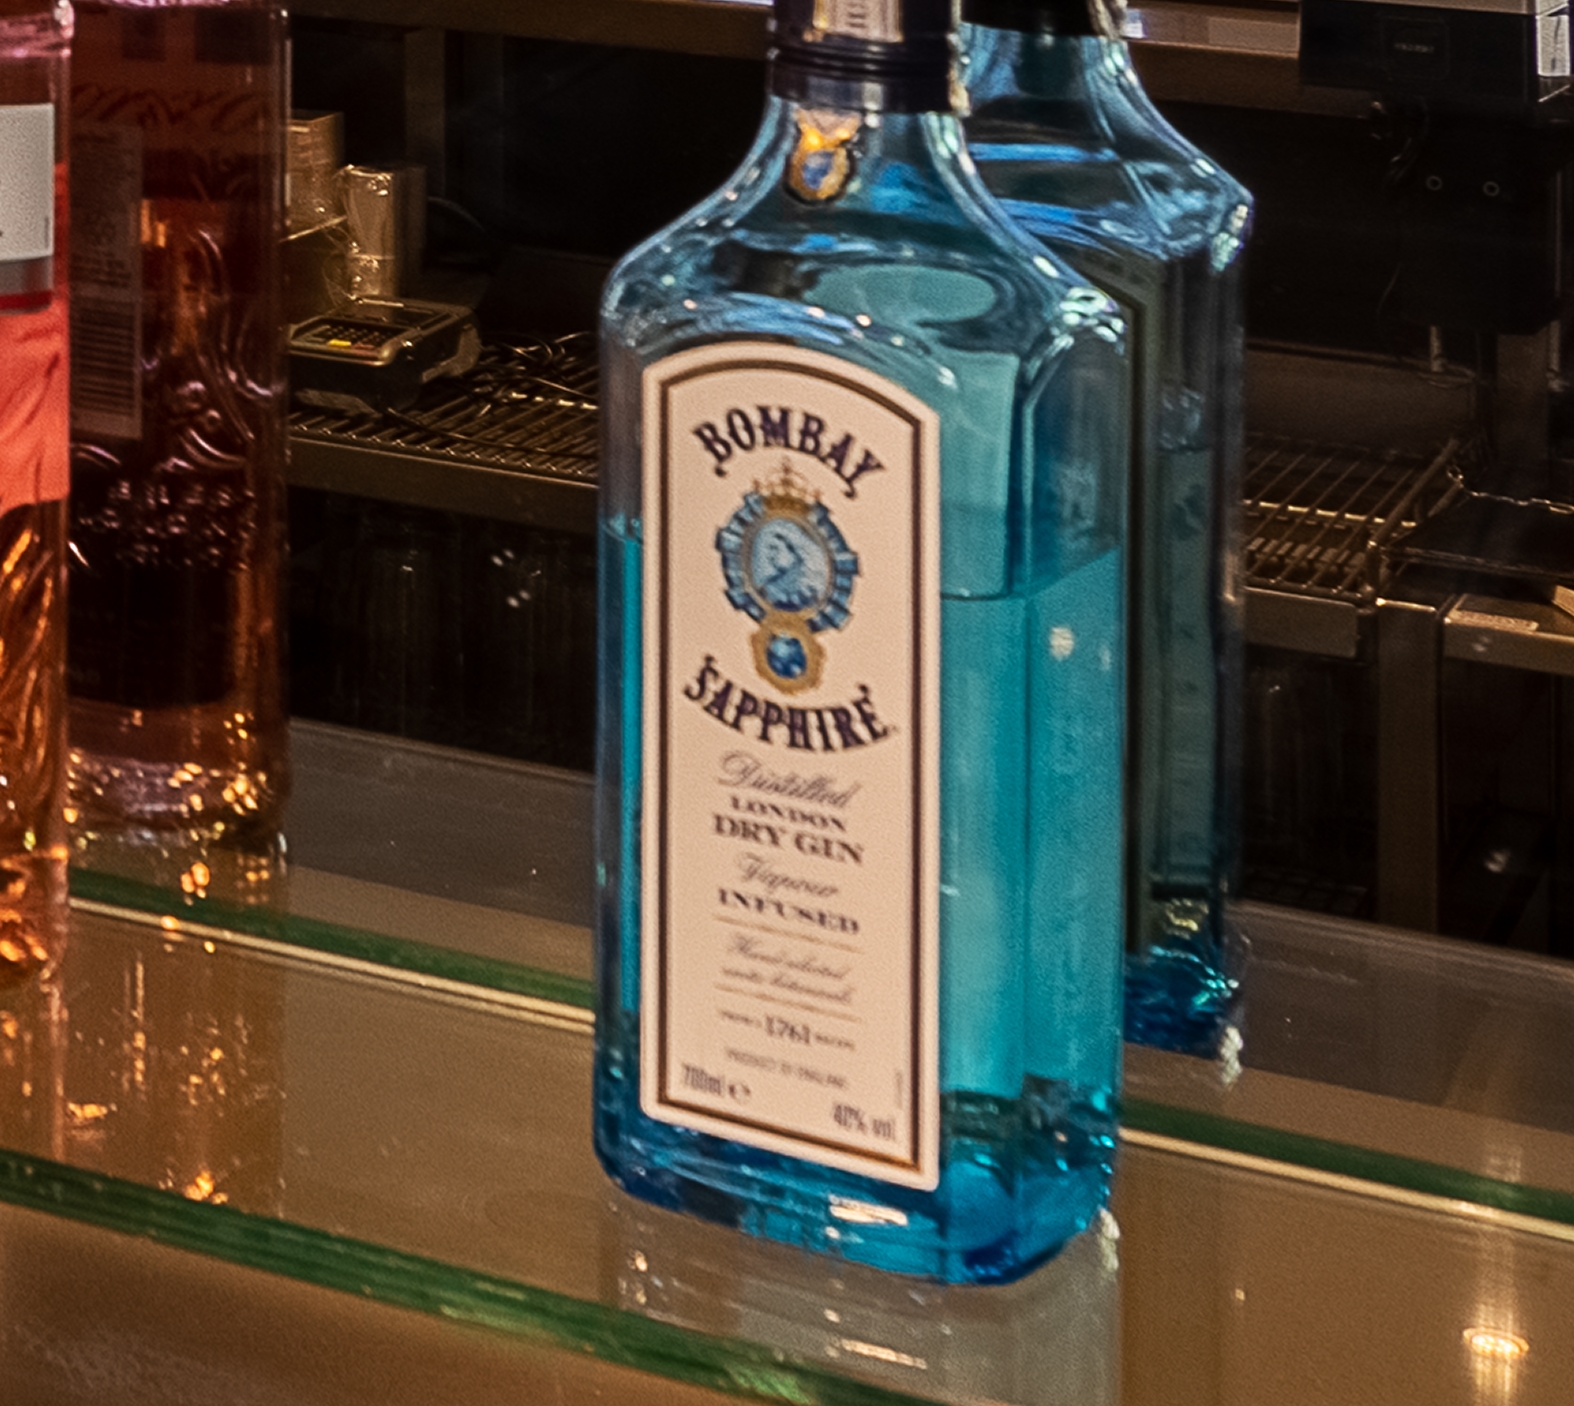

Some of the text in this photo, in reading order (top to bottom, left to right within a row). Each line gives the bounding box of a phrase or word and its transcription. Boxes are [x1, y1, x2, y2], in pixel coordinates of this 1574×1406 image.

[691, 404, 886, 500] BOMBAY
[683, 653, 892, 753] SAPPHIRE
[716, 748, 864, 810] Distilled
[729, 794, 848, 833] LONDON
[711, 813, 866, 866] DRY GIN
[737, 851, 840, 899] Vapour
[717, 887, 861, 936] INFUSED
[764, 1012, 813, 1046] 1761
